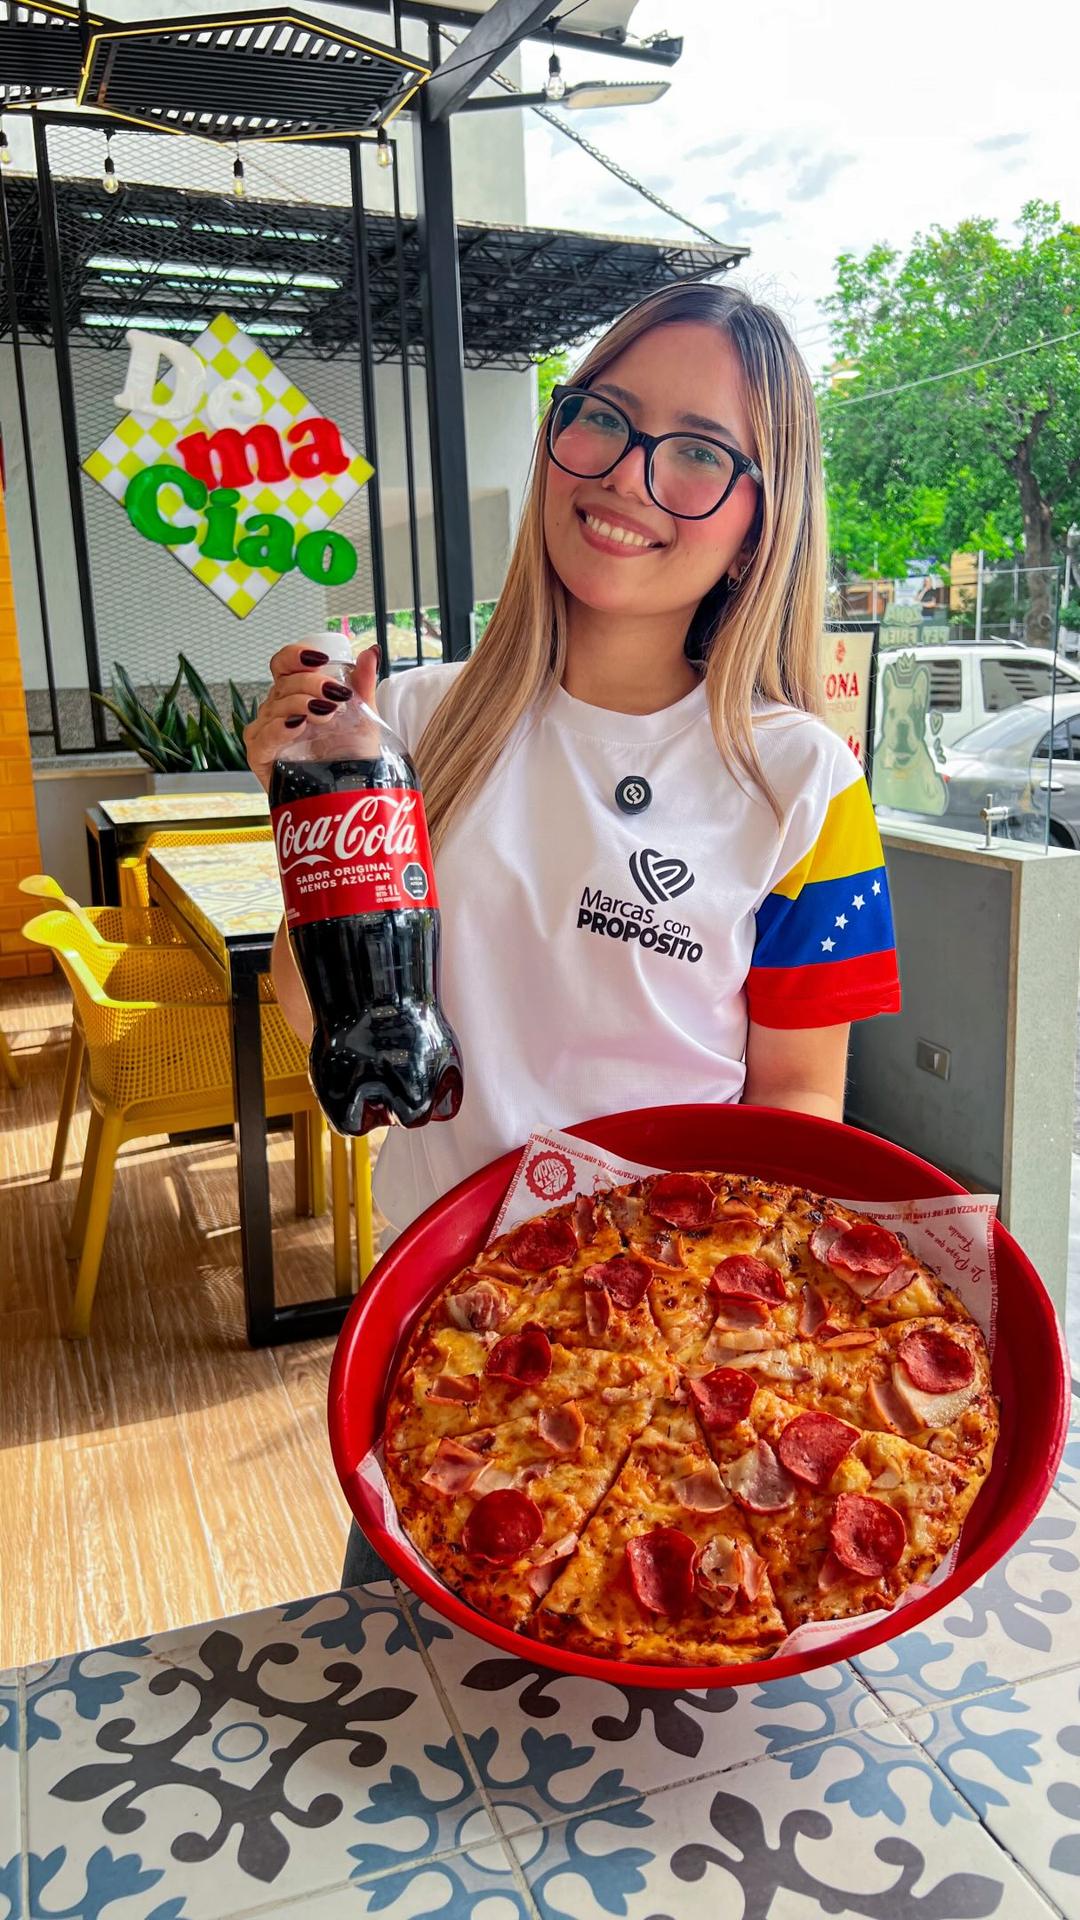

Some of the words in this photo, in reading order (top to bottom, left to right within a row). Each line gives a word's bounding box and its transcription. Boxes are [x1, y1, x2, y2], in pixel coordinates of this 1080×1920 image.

[113, 328, 264, 431] De
[175, 416, 352, 492] ma
[124, 463, 359, 587] Ciao
[824, 672, 860, 700] ONA
[276, 795, 417, 875] Coca-Cola
[296, 870, 331, 886] SABOR
[333, 861, 394, 877] ORIGINAL
[299, 879, 338, 895] MENOS
[341, 870, 392, 887] AZÚCAR
[579, 886, 656, 925] Marcas
[576, 907, 704, 963] PROPÓSITO
[663, 919, 692, 938] con
[957, 1205, 978, 1214] PIZZA
[933, 1237, 946, 1249] que
[944, 1246, 971, 1271] Pizza
[971, 1264, 986, 1284] La
